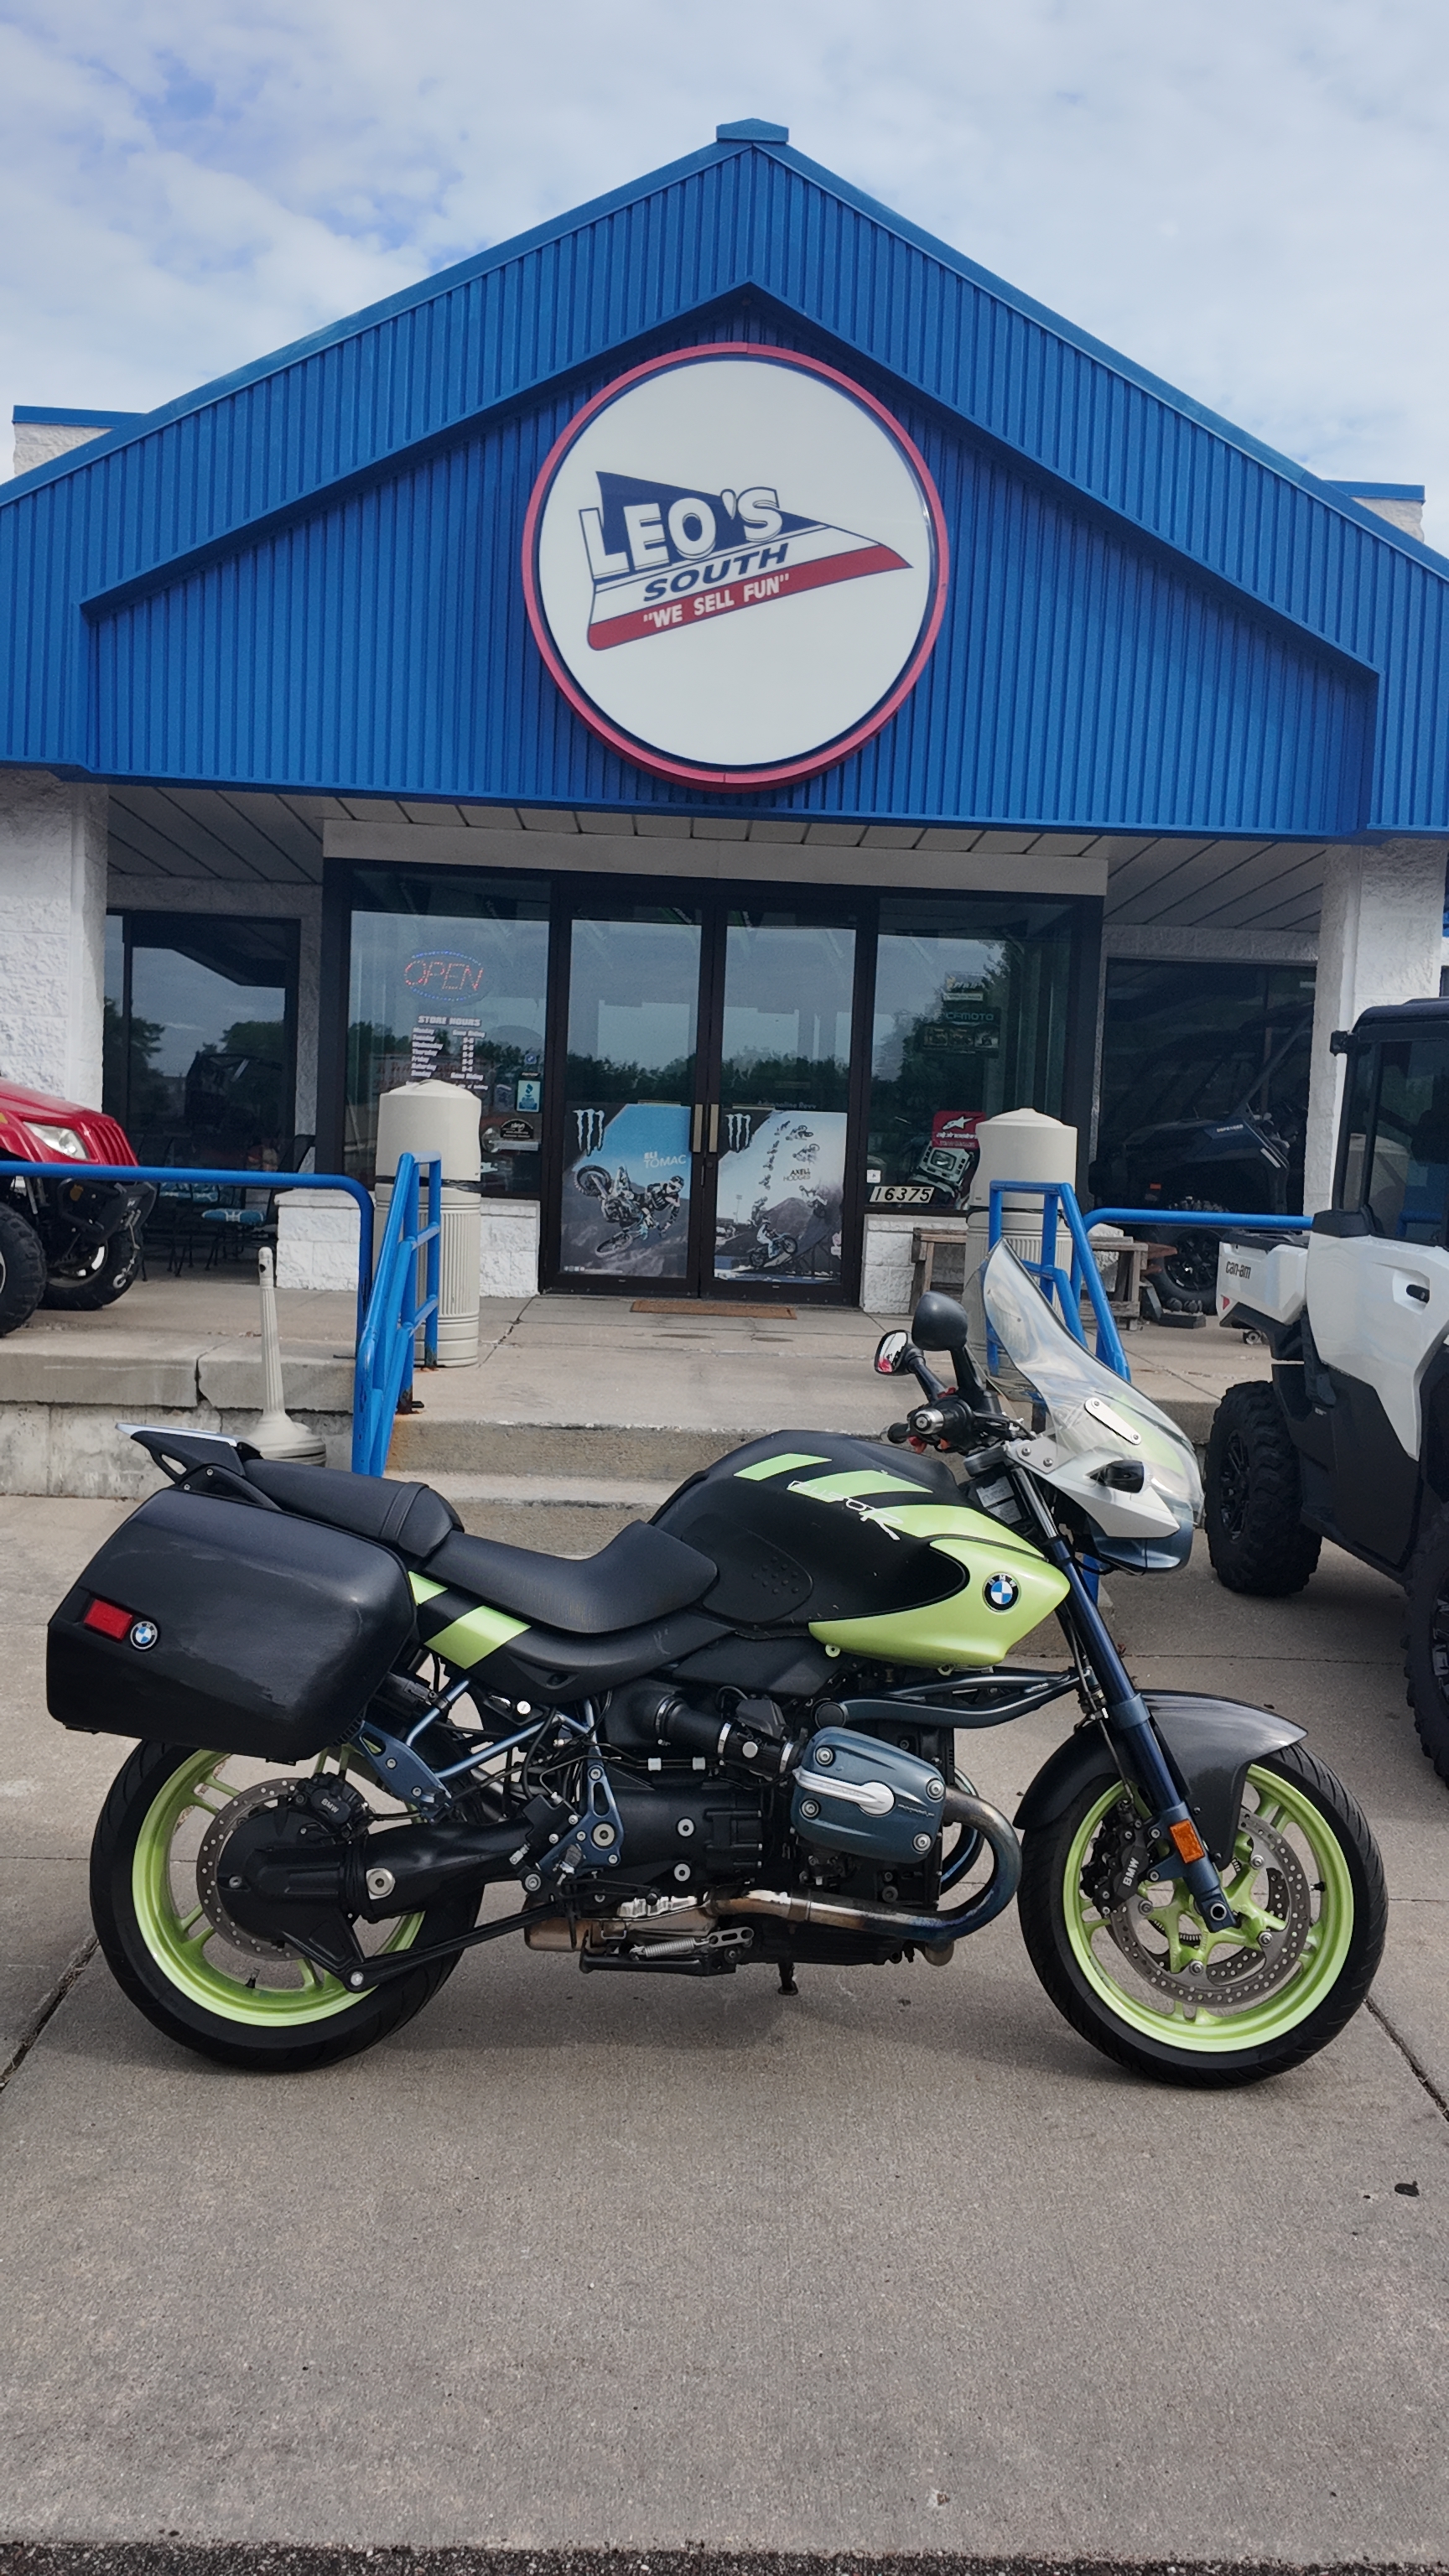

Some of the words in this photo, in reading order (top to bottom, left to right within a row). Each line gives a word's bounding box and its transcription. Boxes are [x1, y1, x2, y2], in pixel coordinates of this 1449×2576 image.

[579, 486, 783, 579] LEO'S
[643, 543, 789, 602] SOUTH
[643, 604, 683, 628] "WE
[693, 589, 735, 616] SELL
[743, 573, 790, 602] FUN"
[404, 959, 484, 991] OPEN
[418, 1015, 447, 1025] STORE
[449, 1017, 481, 1027] HOURS
[946, 1011, 995, 1021] CFMOTO
[643, 1155, 687, 1169] TOMAC
[644, 1151, 658, 1160] ELI
[875, 1187, 932, 1202] 16375
[1226, 1260, 1252, 1280] can-am
[321, 1798, 340, 1813] BMW
[1122, 1857, 1140, 1887] BMW
